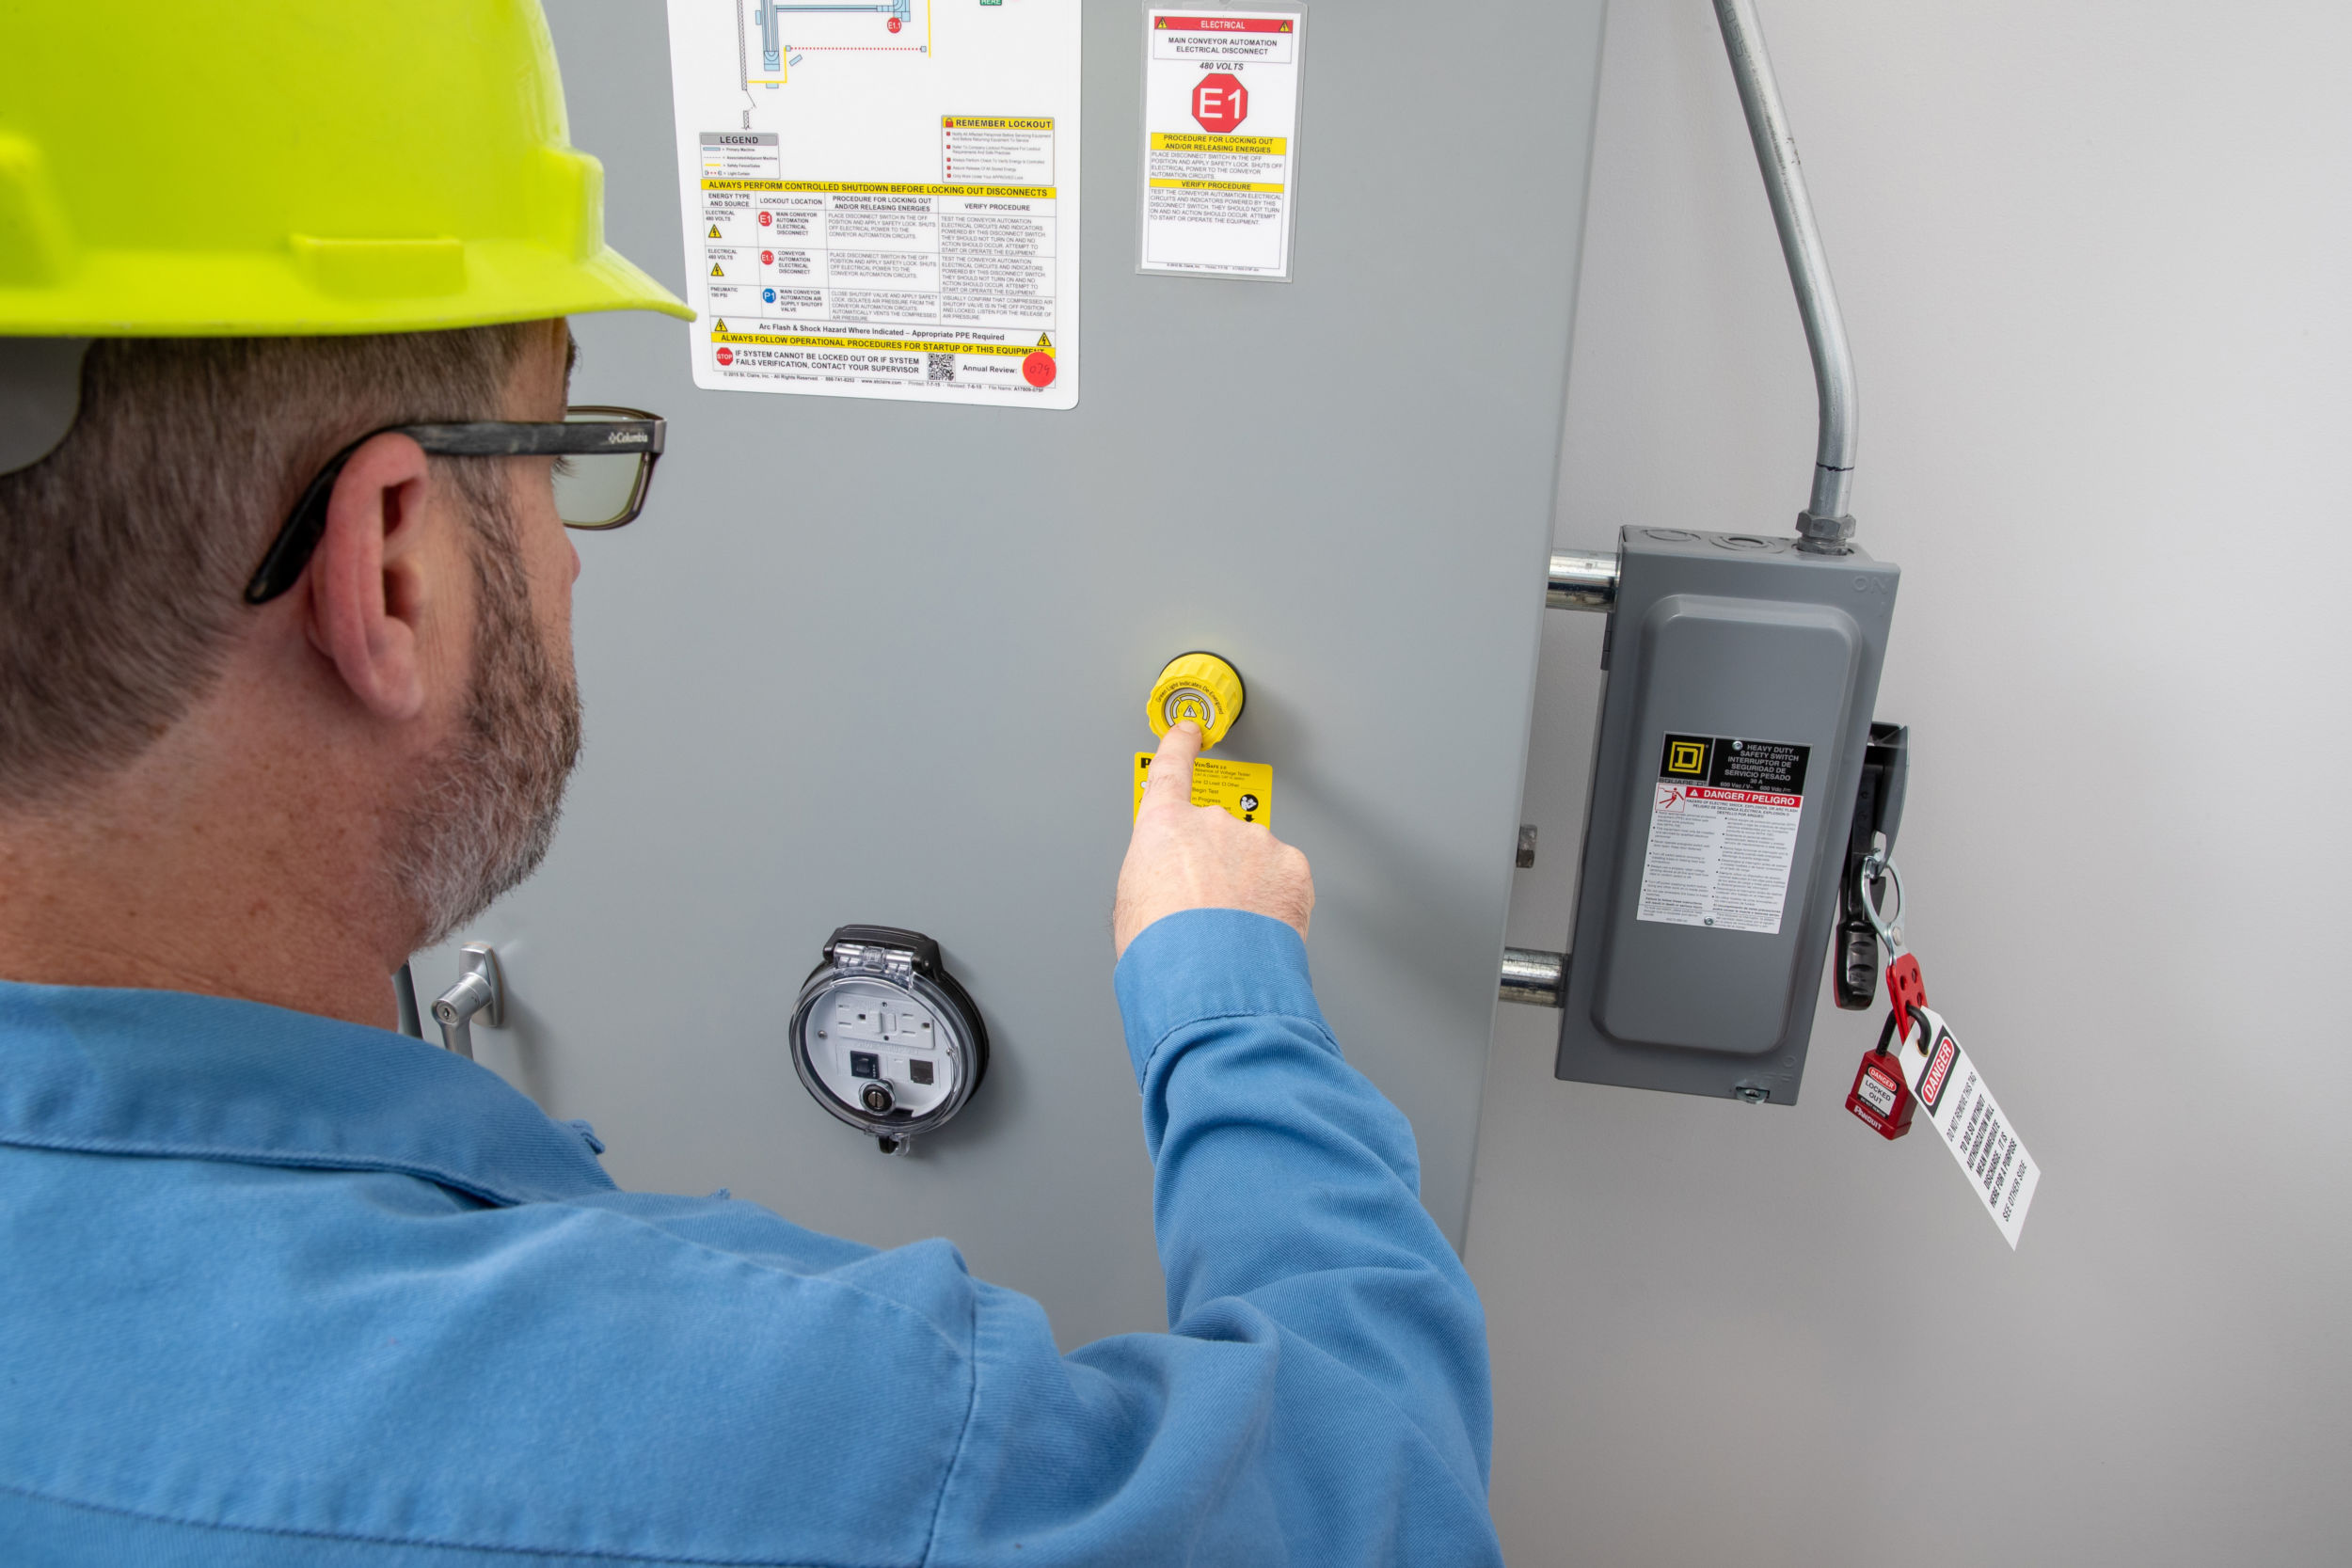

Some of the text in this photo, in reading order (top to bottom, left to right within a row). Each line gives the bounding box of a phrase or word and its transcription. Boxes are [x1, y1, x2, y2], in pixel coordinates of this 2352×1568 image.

[888, 22, 901, 30] E1.1
[1200, 20, 1245, 30] ELECTRICAL
[1199, 87, 1241, 119] E1
[986, 188, 1047, 197] DISCONNECTS
[759, 214, 771, 223] E1
[721, 335, 753, 343] ALWAYS
[789, 338, 844, 347] OPERATIONAL
[847, 341, 901, 350] PROCEDURES
[923, 343, 960, 352] STARTUP
[617, 433, 647, 443] Columbia
[1727, 756, 1779, 767] INTERRUPTOR
[1730, 764, 1774, 773] SEGURIDAD
[1724, 769, 1758, 778] SERVICIO
[1703, 790, 1744, 800] DANGER
[1751, 795, 1794, 805] PELIGRO
[1870, 1069, 1894, 1088] DANGER
[1924, 1043, 1951, 1100] DANGER
[1866, 1080, 1891, 1101] LOCKED
[1869, 1092, 1883, 1104] OUT
[1954, 1094, 1968, 1123] REMOVE
[1854, 1105, 1882, 1130] PANDUIT
[1949, 1116, 1959, 1134] NOT
[1959, 1093, 1985, 1155] TO DO SO WITHOUT
[1946, 1127, 1955, 1143] DO
[1966, 1103, 1994, 1172] AUTHORIZATION WILL
[2000, 1131, 2008, 1145] IS
[1976, 1118, 2000, 1179] MEAN IMMEDIATE
[1997, 1138, 2005, 1152] IT
[1989, 1185, 2000, 1210] HERE
[1995, 1172, 2005, 1192] FOR
[2002, 1137, 2017, 1173] PURPOSE
[2002, 1159, 2027, 1223] SEE OTHER SIDE
